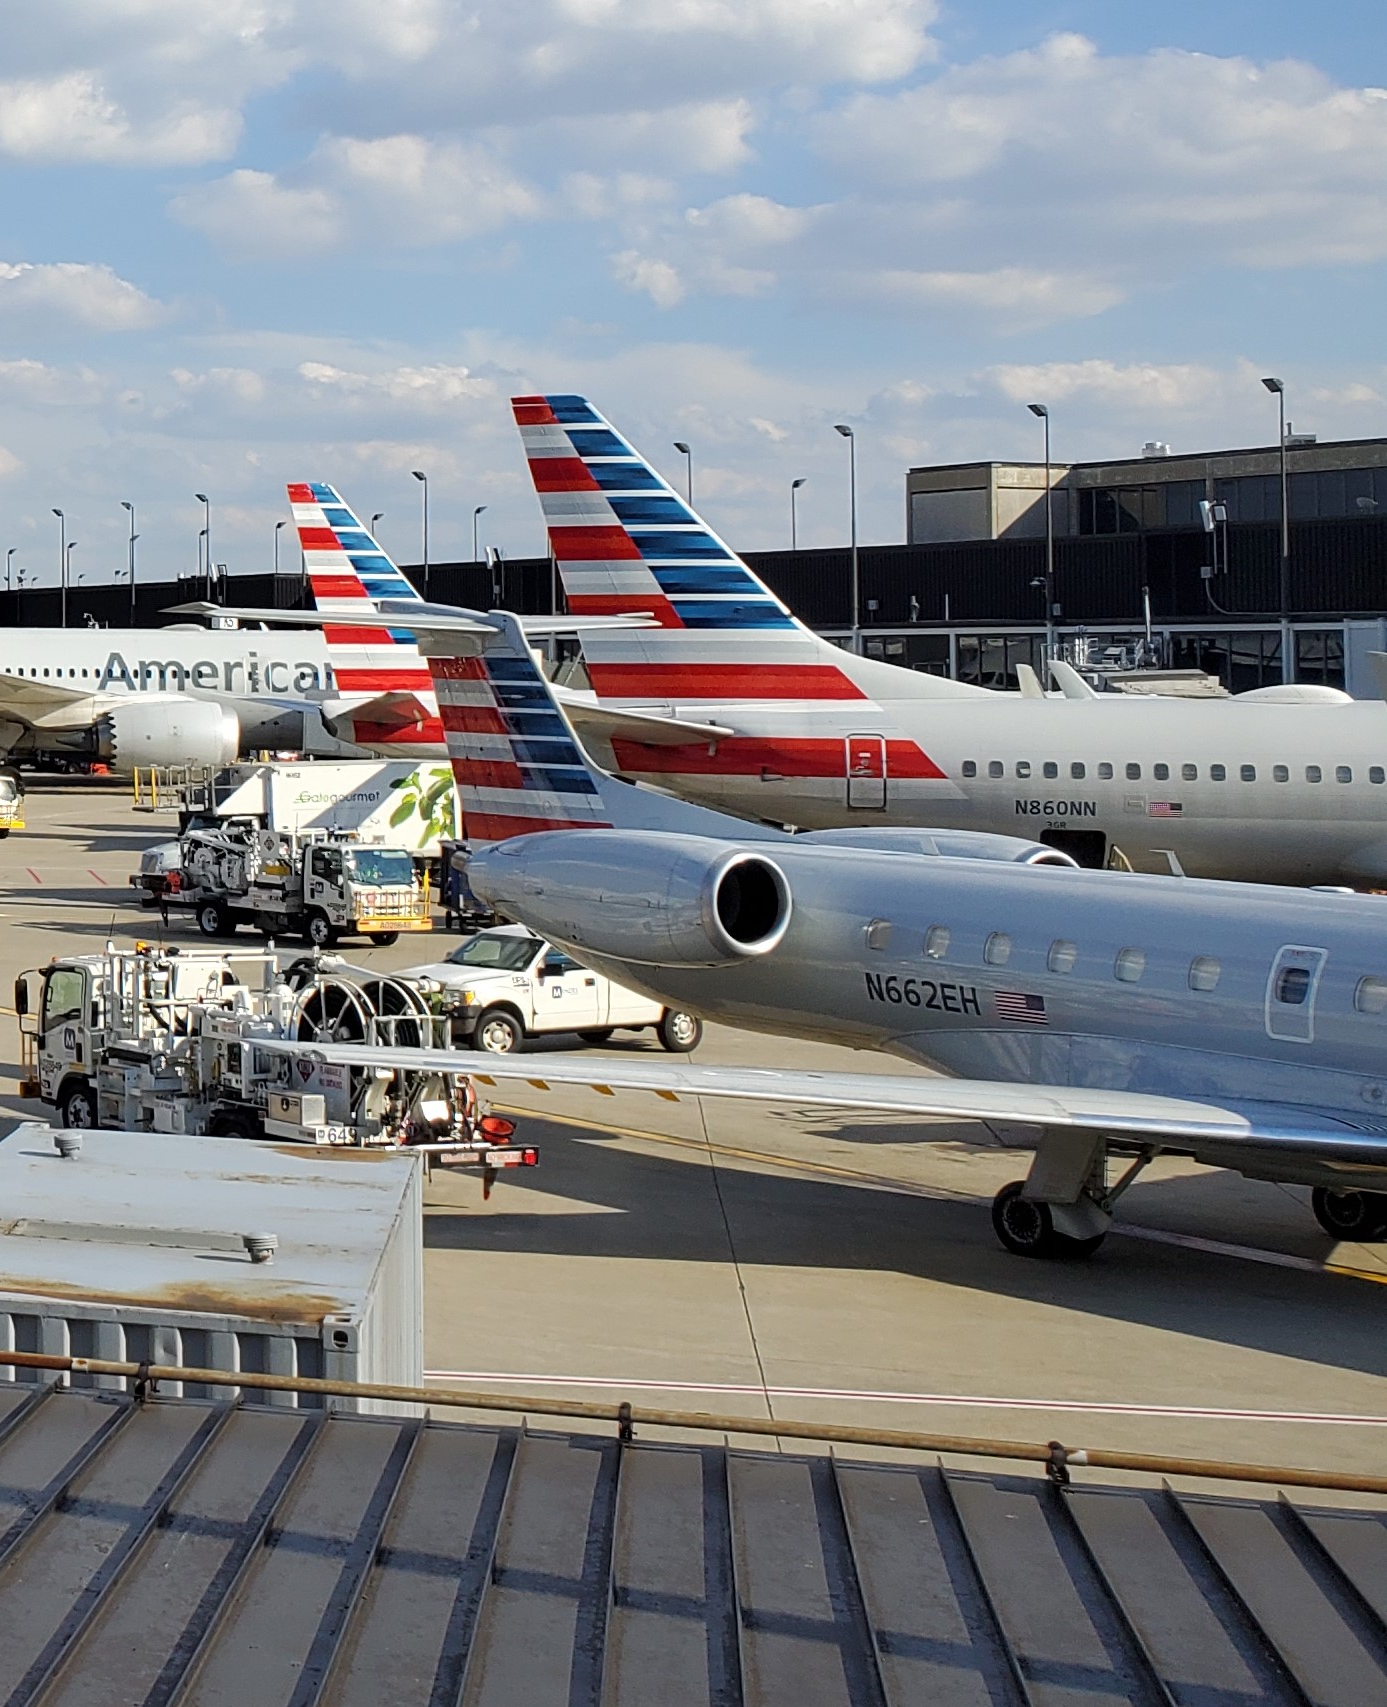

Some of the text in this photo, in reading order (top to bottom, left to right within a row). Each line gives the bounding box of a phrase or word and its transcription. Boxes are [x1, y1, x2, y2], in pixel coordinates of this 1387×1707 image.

[1015, 800, 1096, 816] N860NN
[864, 972, 982, 1016] N662EH
[327, 1127, 357, 1143] 649
